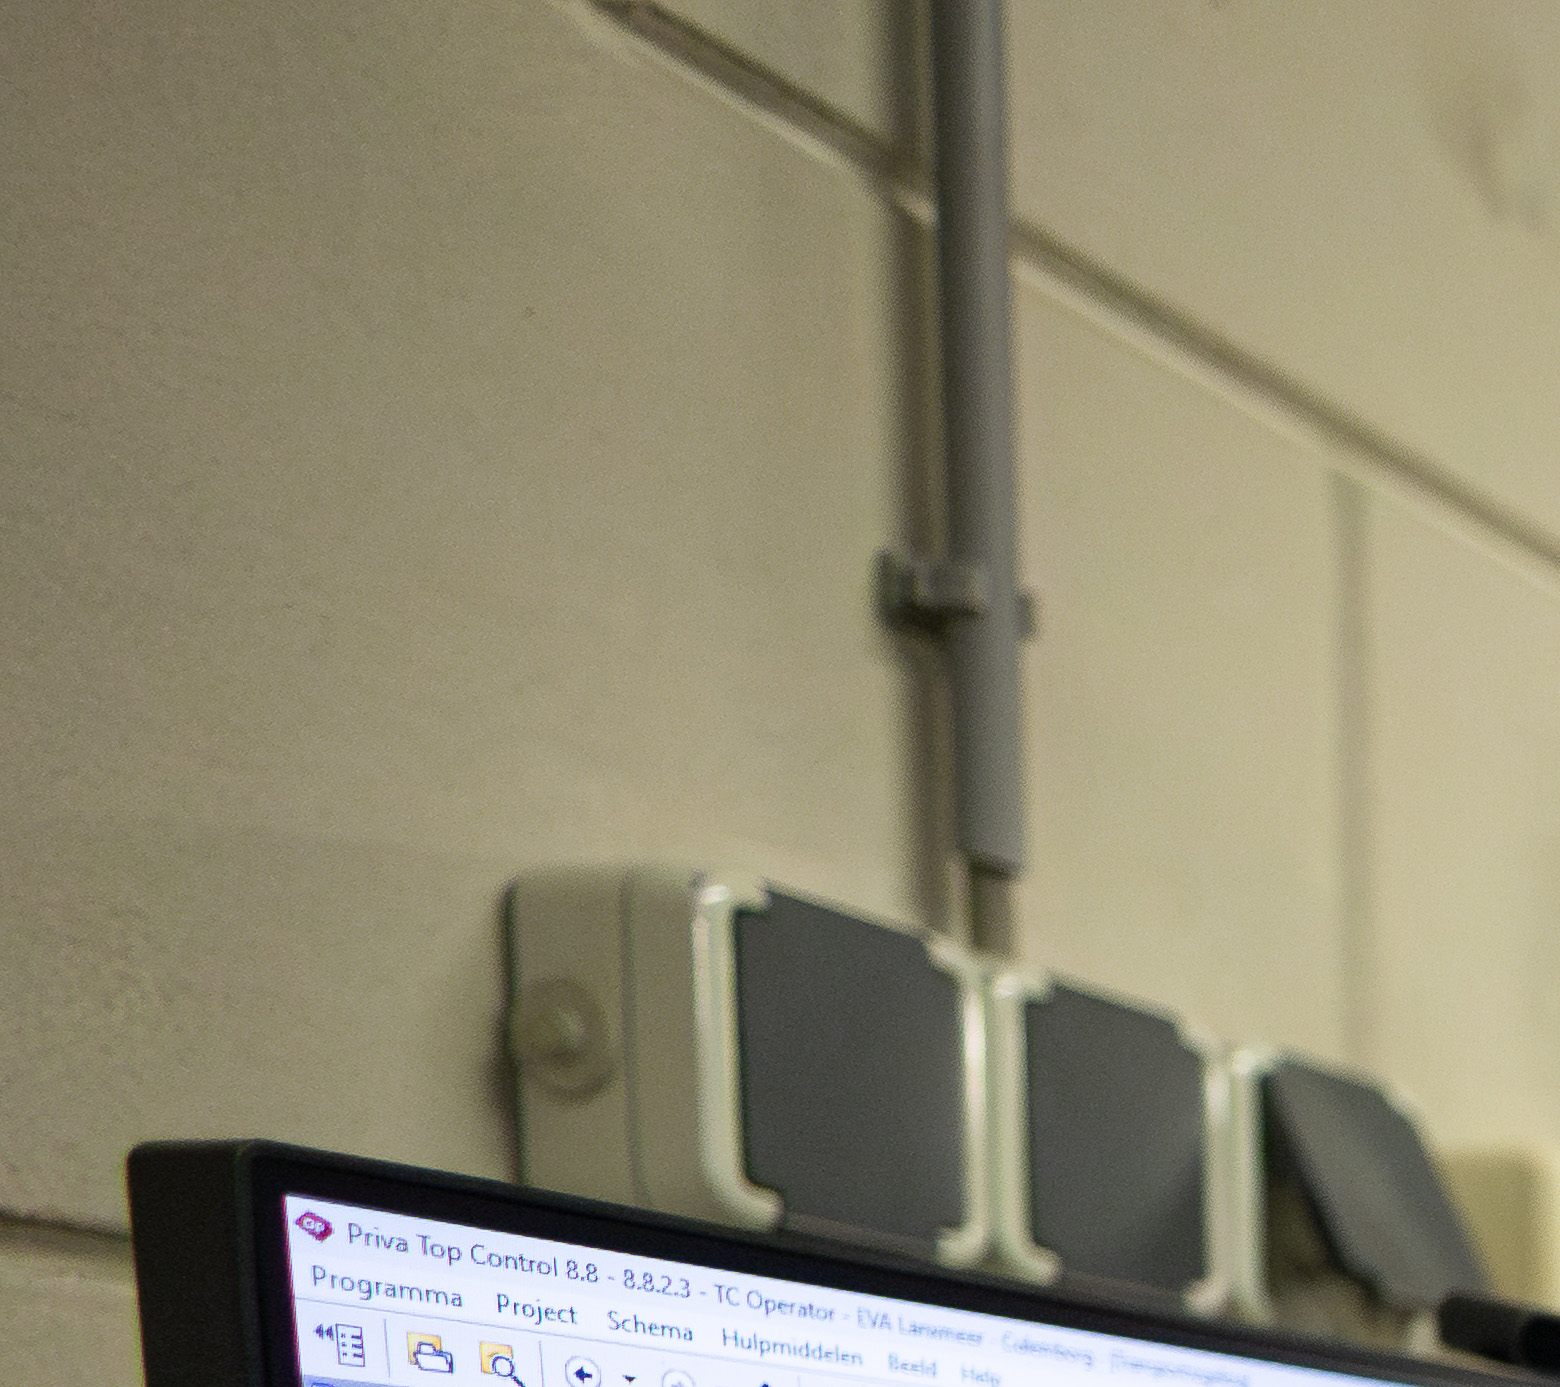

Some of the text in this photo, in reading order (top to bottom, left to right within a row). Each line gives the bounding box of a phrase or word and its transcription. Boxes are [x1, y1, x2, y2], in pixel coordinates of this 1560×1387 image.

[312, 1265, 462, 1307] Programma
[496, 1293, 578, 1325] Project
[607, 1310, 693, 1341] Schema
[722, 1328, 863, 1366] Hulpmiddelen
[348, 1222, 409, 1253] Priva
[417, 1234, 462, 1266] Top
[470, 1244, 558, 1277] Control
[567, 1259, 599, 1283] 8.8
[624, 1269, 690, 1298] 8.8.2.3
[714, 1284, 740, 1306] TC
[747, 1290, 834, 1321] Operator
[857, 1306, 892, 1330] EVA
